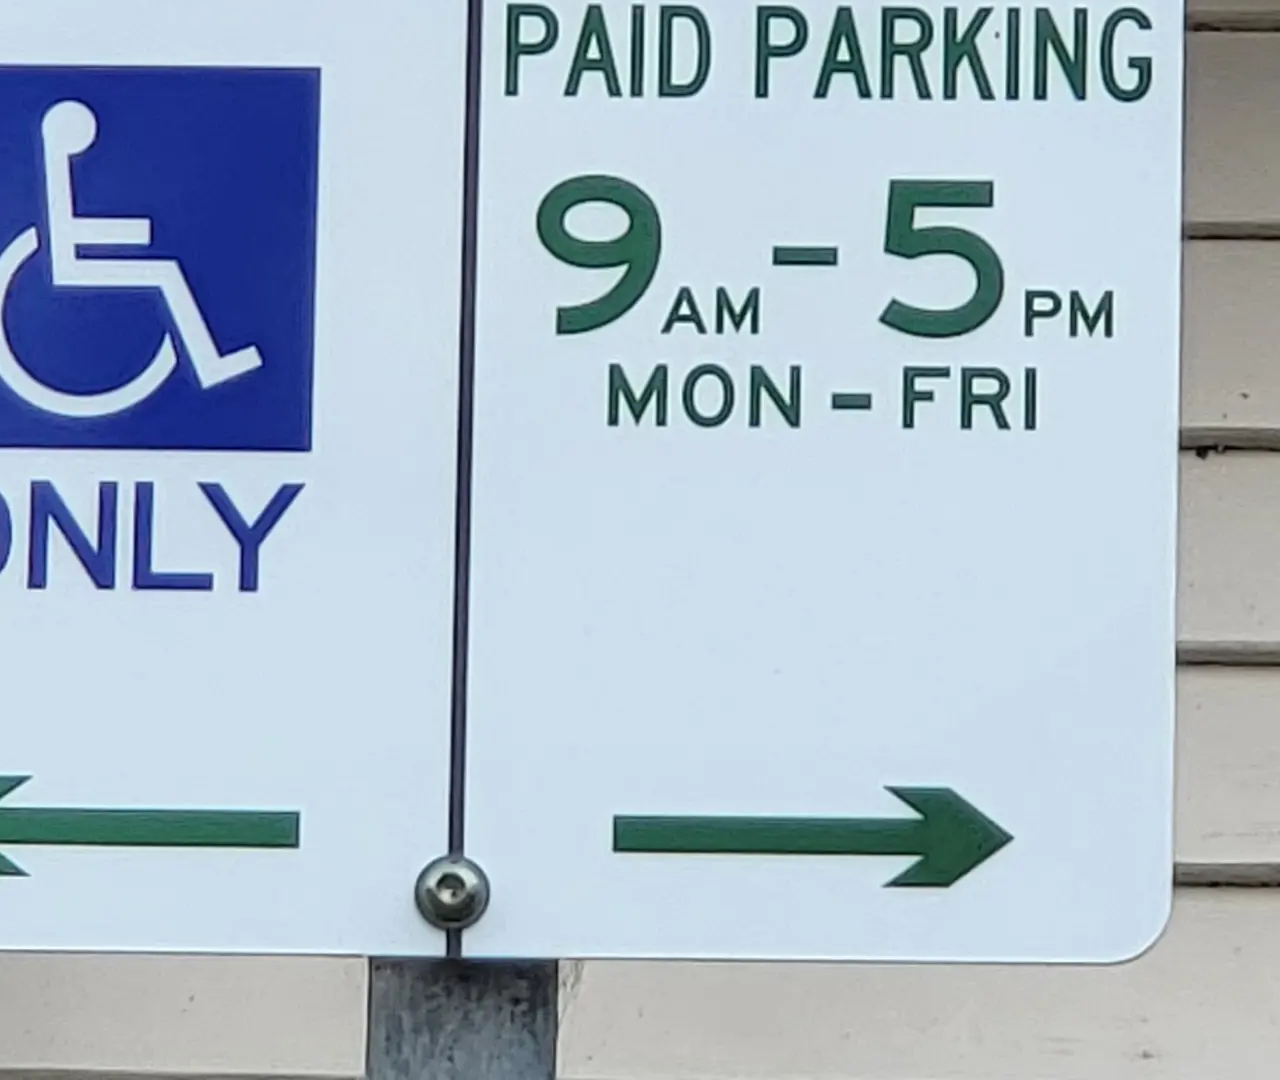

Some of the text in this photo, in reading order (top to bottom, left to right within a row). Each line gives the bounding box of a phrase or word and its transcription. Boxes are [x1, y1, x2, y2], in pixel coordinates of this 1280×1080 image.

[502, 2, 1154, 105] PAID PARKING
[605, 362, 803, 430] MON
[901, 364, 1038, 432] FRI
